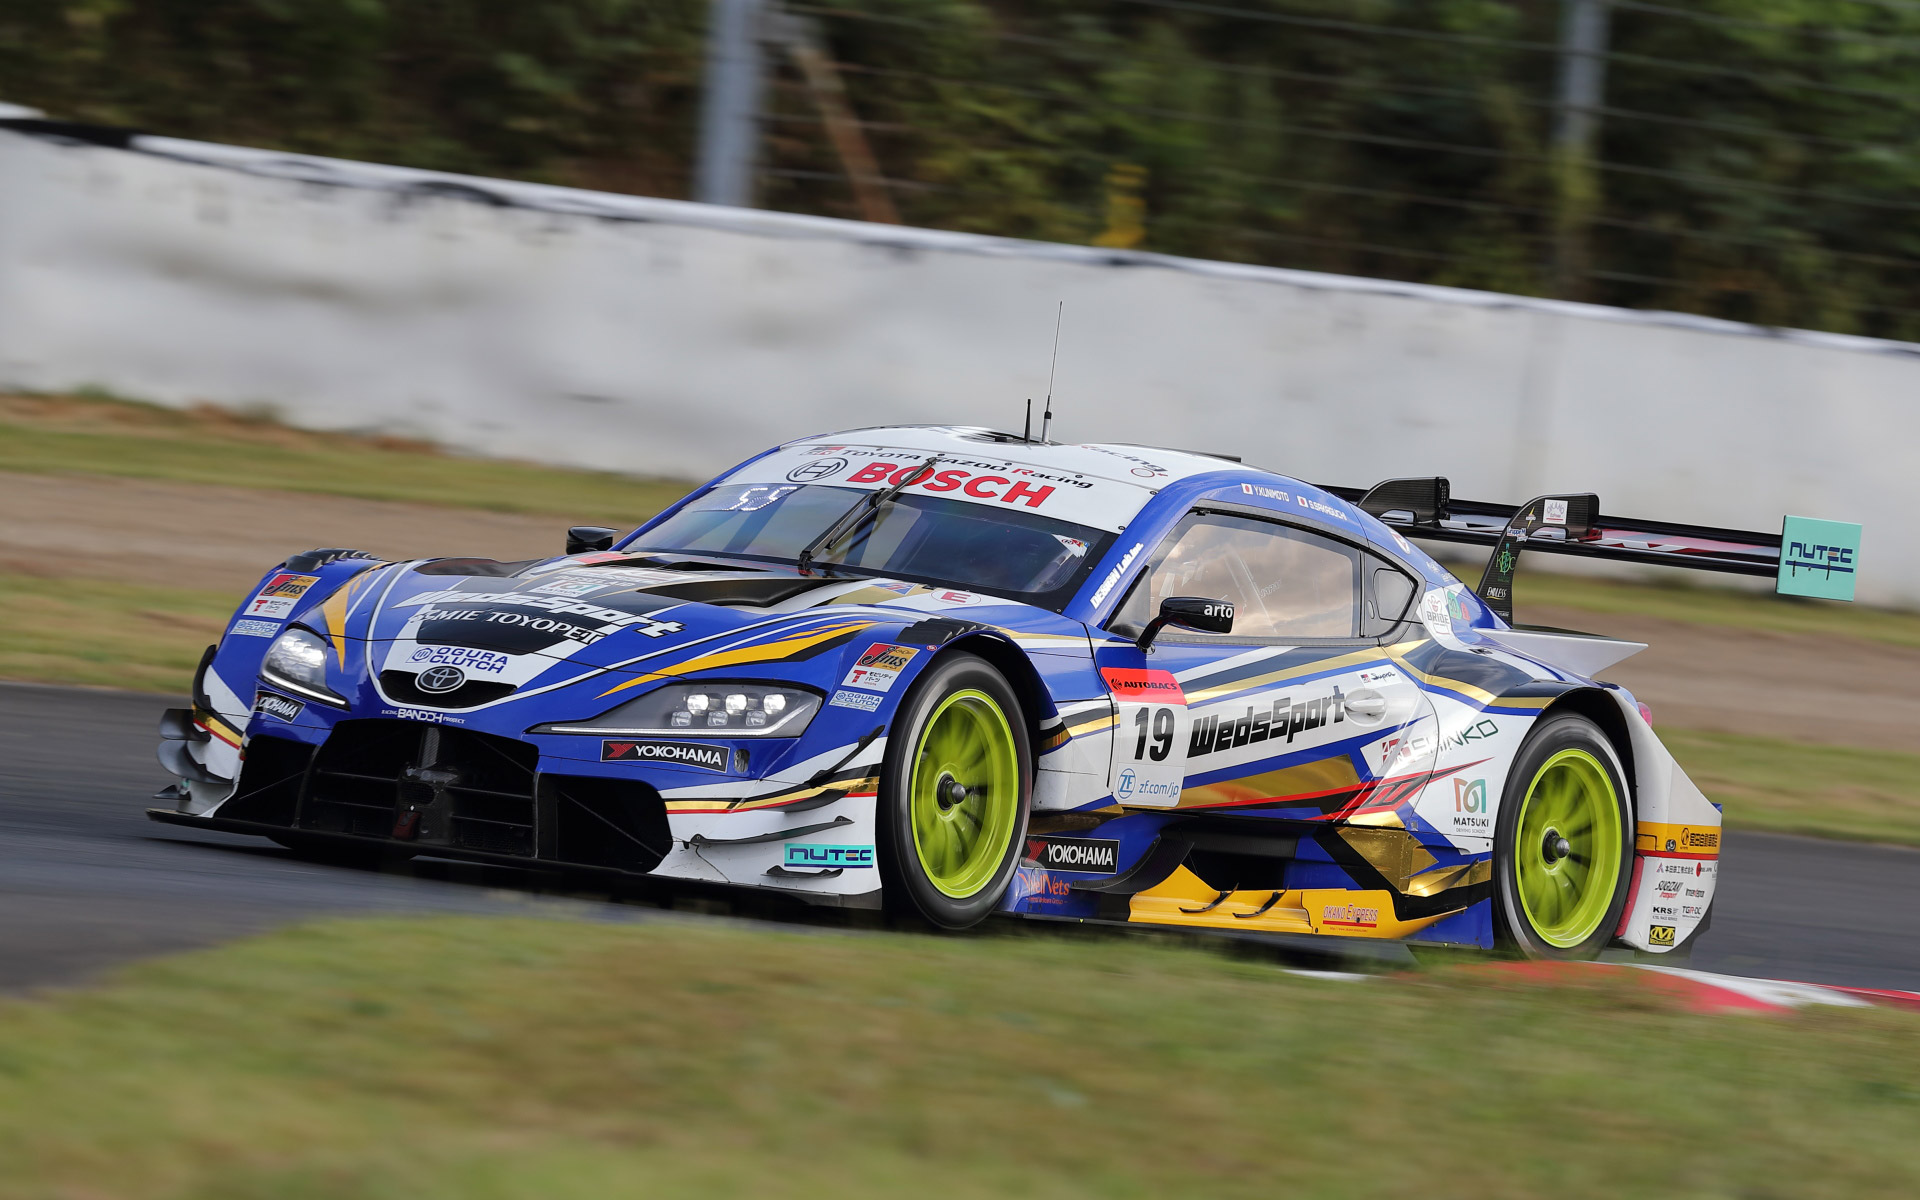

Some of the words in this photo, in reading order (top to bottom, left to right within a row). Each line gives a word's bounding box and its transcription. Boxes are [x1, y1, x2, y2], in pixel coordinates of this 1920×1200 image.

[842, 449, 922, 460] TOYOTA
[1012, 467, 1094, 489] Racing
[846, 461, 1056, 508] BOSCH
[1203, 604, 1234, 619] arto
[1426, 610, 1450, 624] BRIDE
[485, 611, 607, 645] TOYOPET
[437, 646, 509, 665] OGURA
[429, 655, 505, 674] CLUTCH
[1124, 681, 1178, 690] AUTOBACS
[844, 697, 879, 707] CLUTCH
[847, 692, 881, 703] OGURA
[397, 708, 444, 723] BANDOH
[1186, 685, 1345, 759] WedsSport
[1134, 707, 1175, 762] 19
[635, 744, 722, 766] YOKOHAMA
[1119, 774, 1136, 793] ZF
[1139, 780, 1180, 798] zf.com/jp
[1453, 816, 1489, 828] MATSUKI
[789, 848, 872, 861] NUTEC
[1047, 844, 1115, 866] YOKOHAMA
[1323, 904, 1346, 920] OKANO
[1653, 906, 1673, 915] KRS
